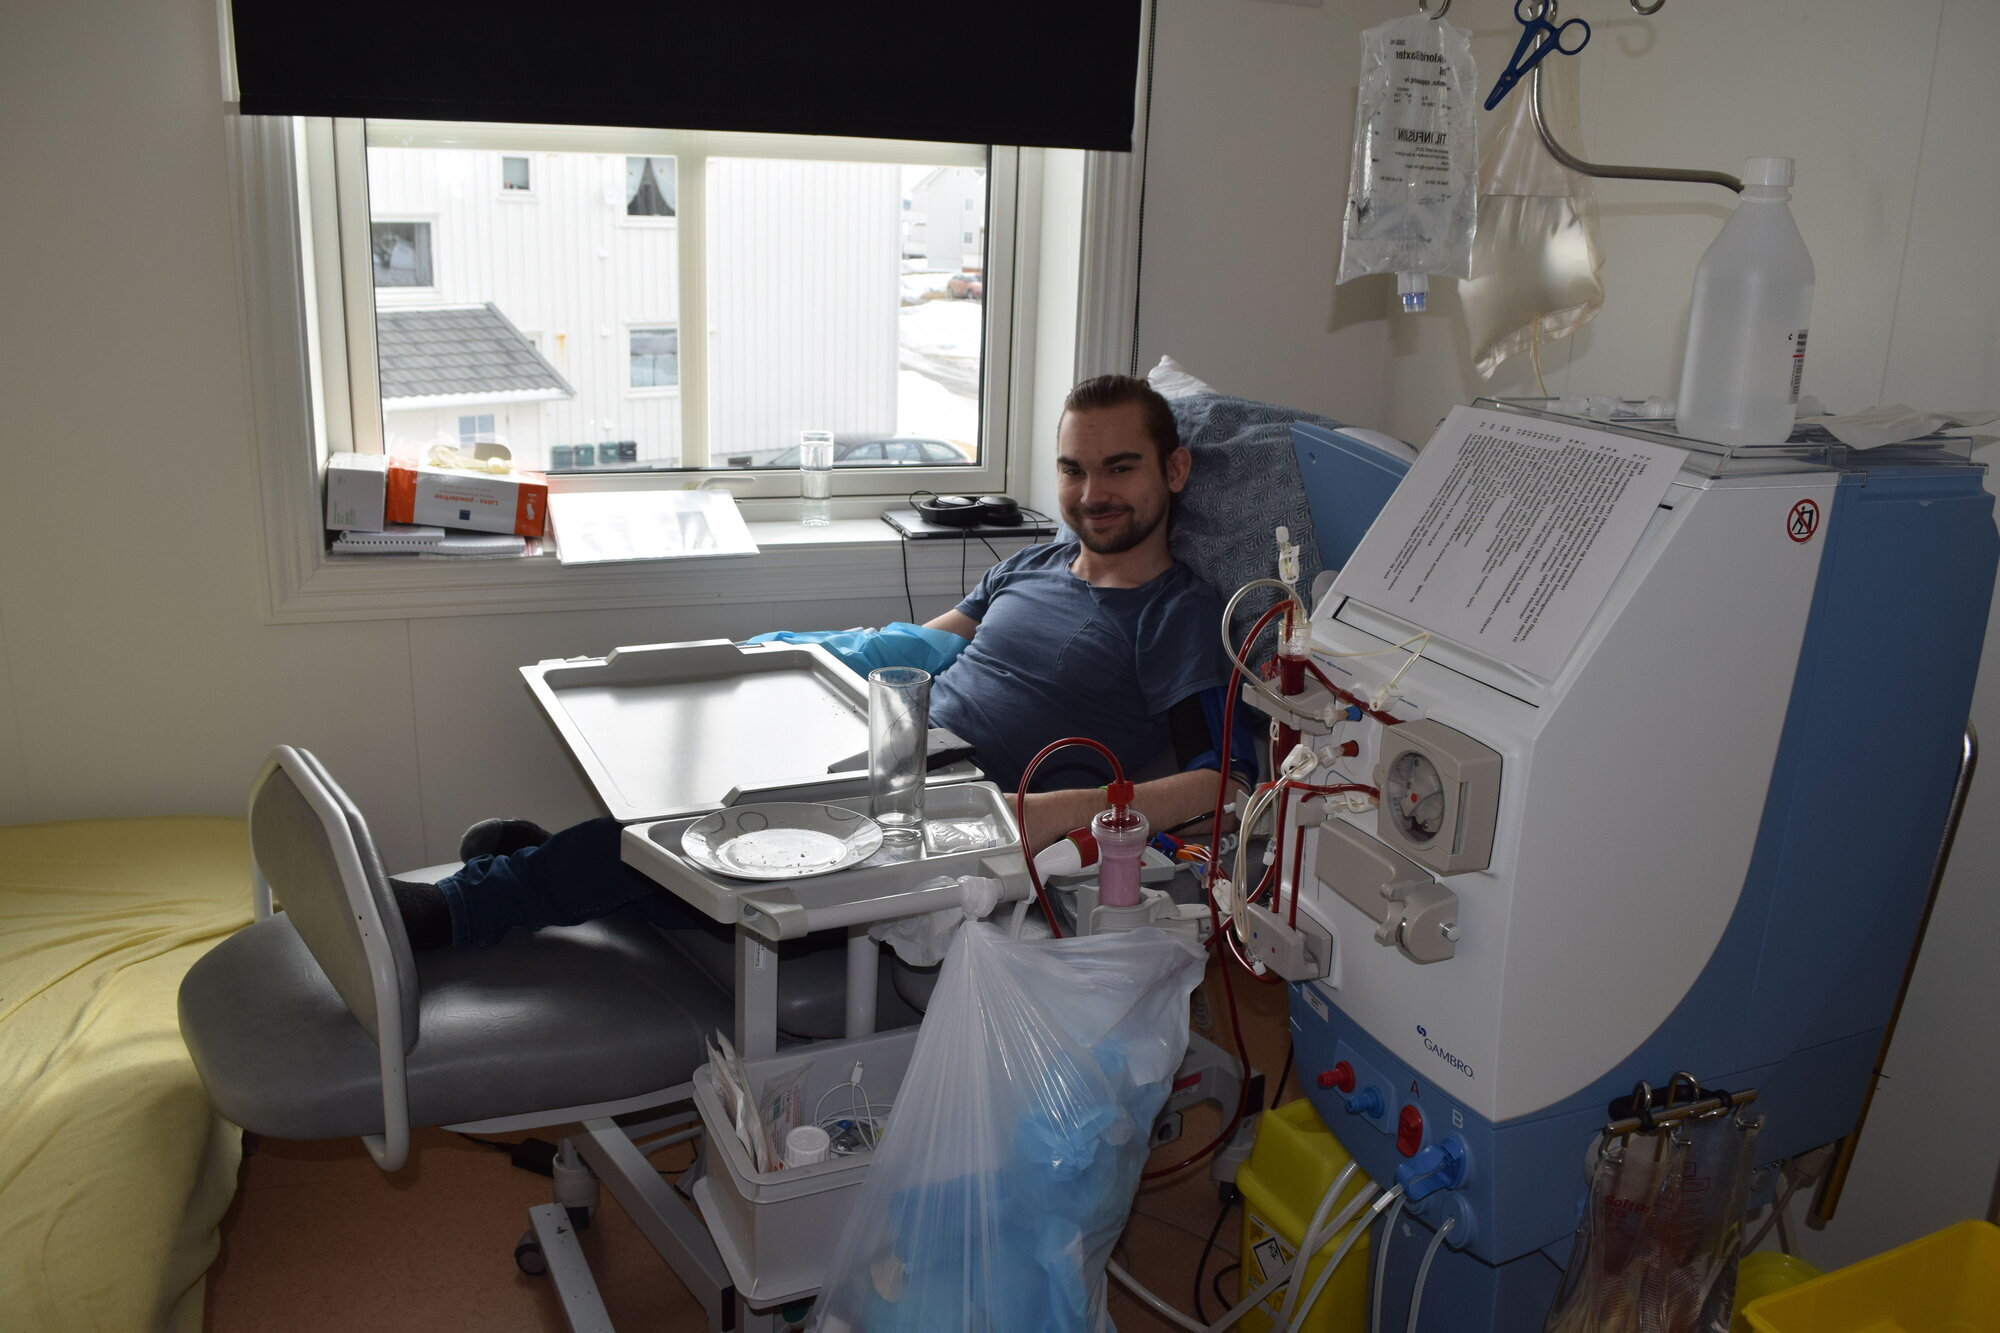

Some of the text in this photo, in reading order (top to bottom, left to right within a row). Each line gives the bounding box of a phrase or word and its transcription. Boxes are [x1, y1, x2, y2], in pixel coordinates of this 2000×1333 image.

[1424, 1037, 1474, 1079] GAMBRO
[1410, 1080, 1420, 1098] A
[1452, 1109, 1463, 1128] B
